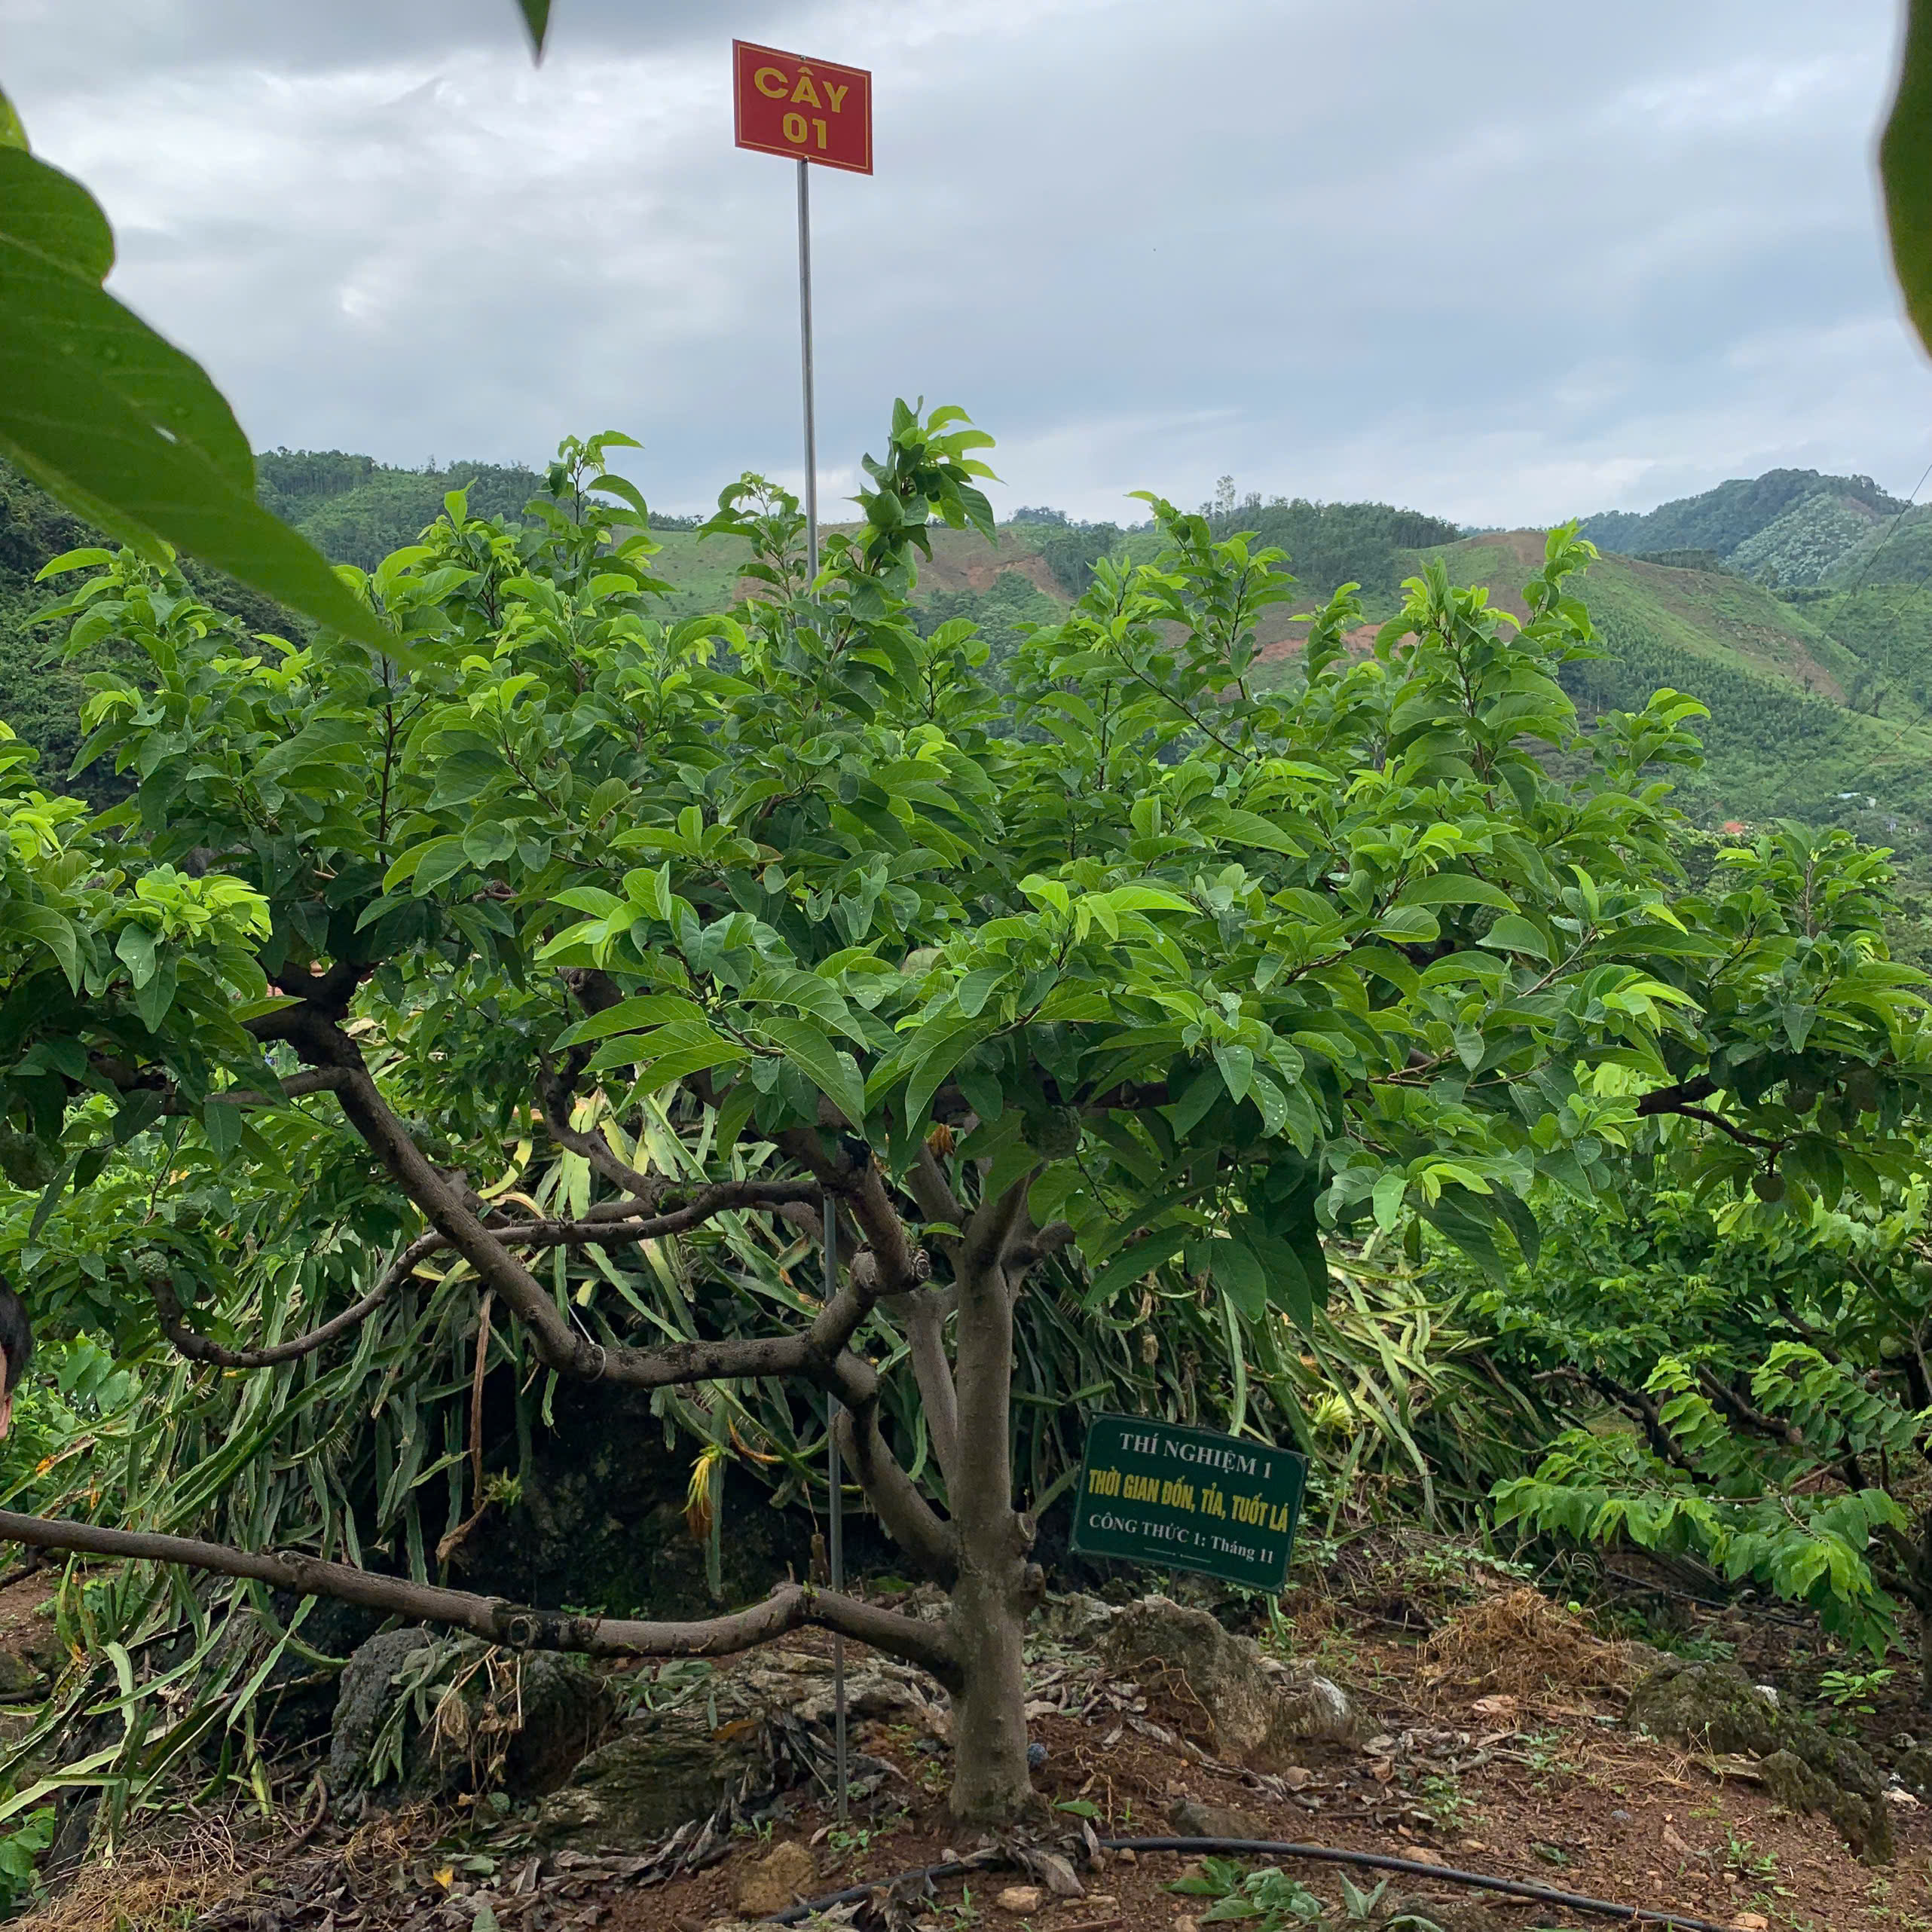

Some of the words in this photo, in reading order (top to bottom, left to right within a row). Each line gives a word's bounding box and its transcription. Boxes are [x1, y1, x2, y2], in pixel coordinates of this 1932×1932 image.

[754, 66, 848, 113] CÂY
[783, 112, 827, 149] 01
[1120, 1432, 1159, 1454] THÍ
[1163, 1439, 1257, 1475] NGHIỆM
[1263, 1462, 1272, 1479] 1
[1089, 1466, 1121, 1496] THỜI
[1123, 1474, 1160, 1502] GIAN
[1161, 1475, 1196, 1513] ĐỐN,
[1201, 1482, 1226, 1520] TỈA,
[1232, 1493, 1268, 1526] TUỐT
[1269, 1502, 1289, 1533] LÁ
[1090, 1512, 1138, 1533] CÔNG
[1142, 1521, 1190, 1543] THỨC
[1194, 1533, 1206, 1547] 1:
[1211, 1535, 1255, 1562] Tháng
[1261, 1548, 1274, 1564] 11
